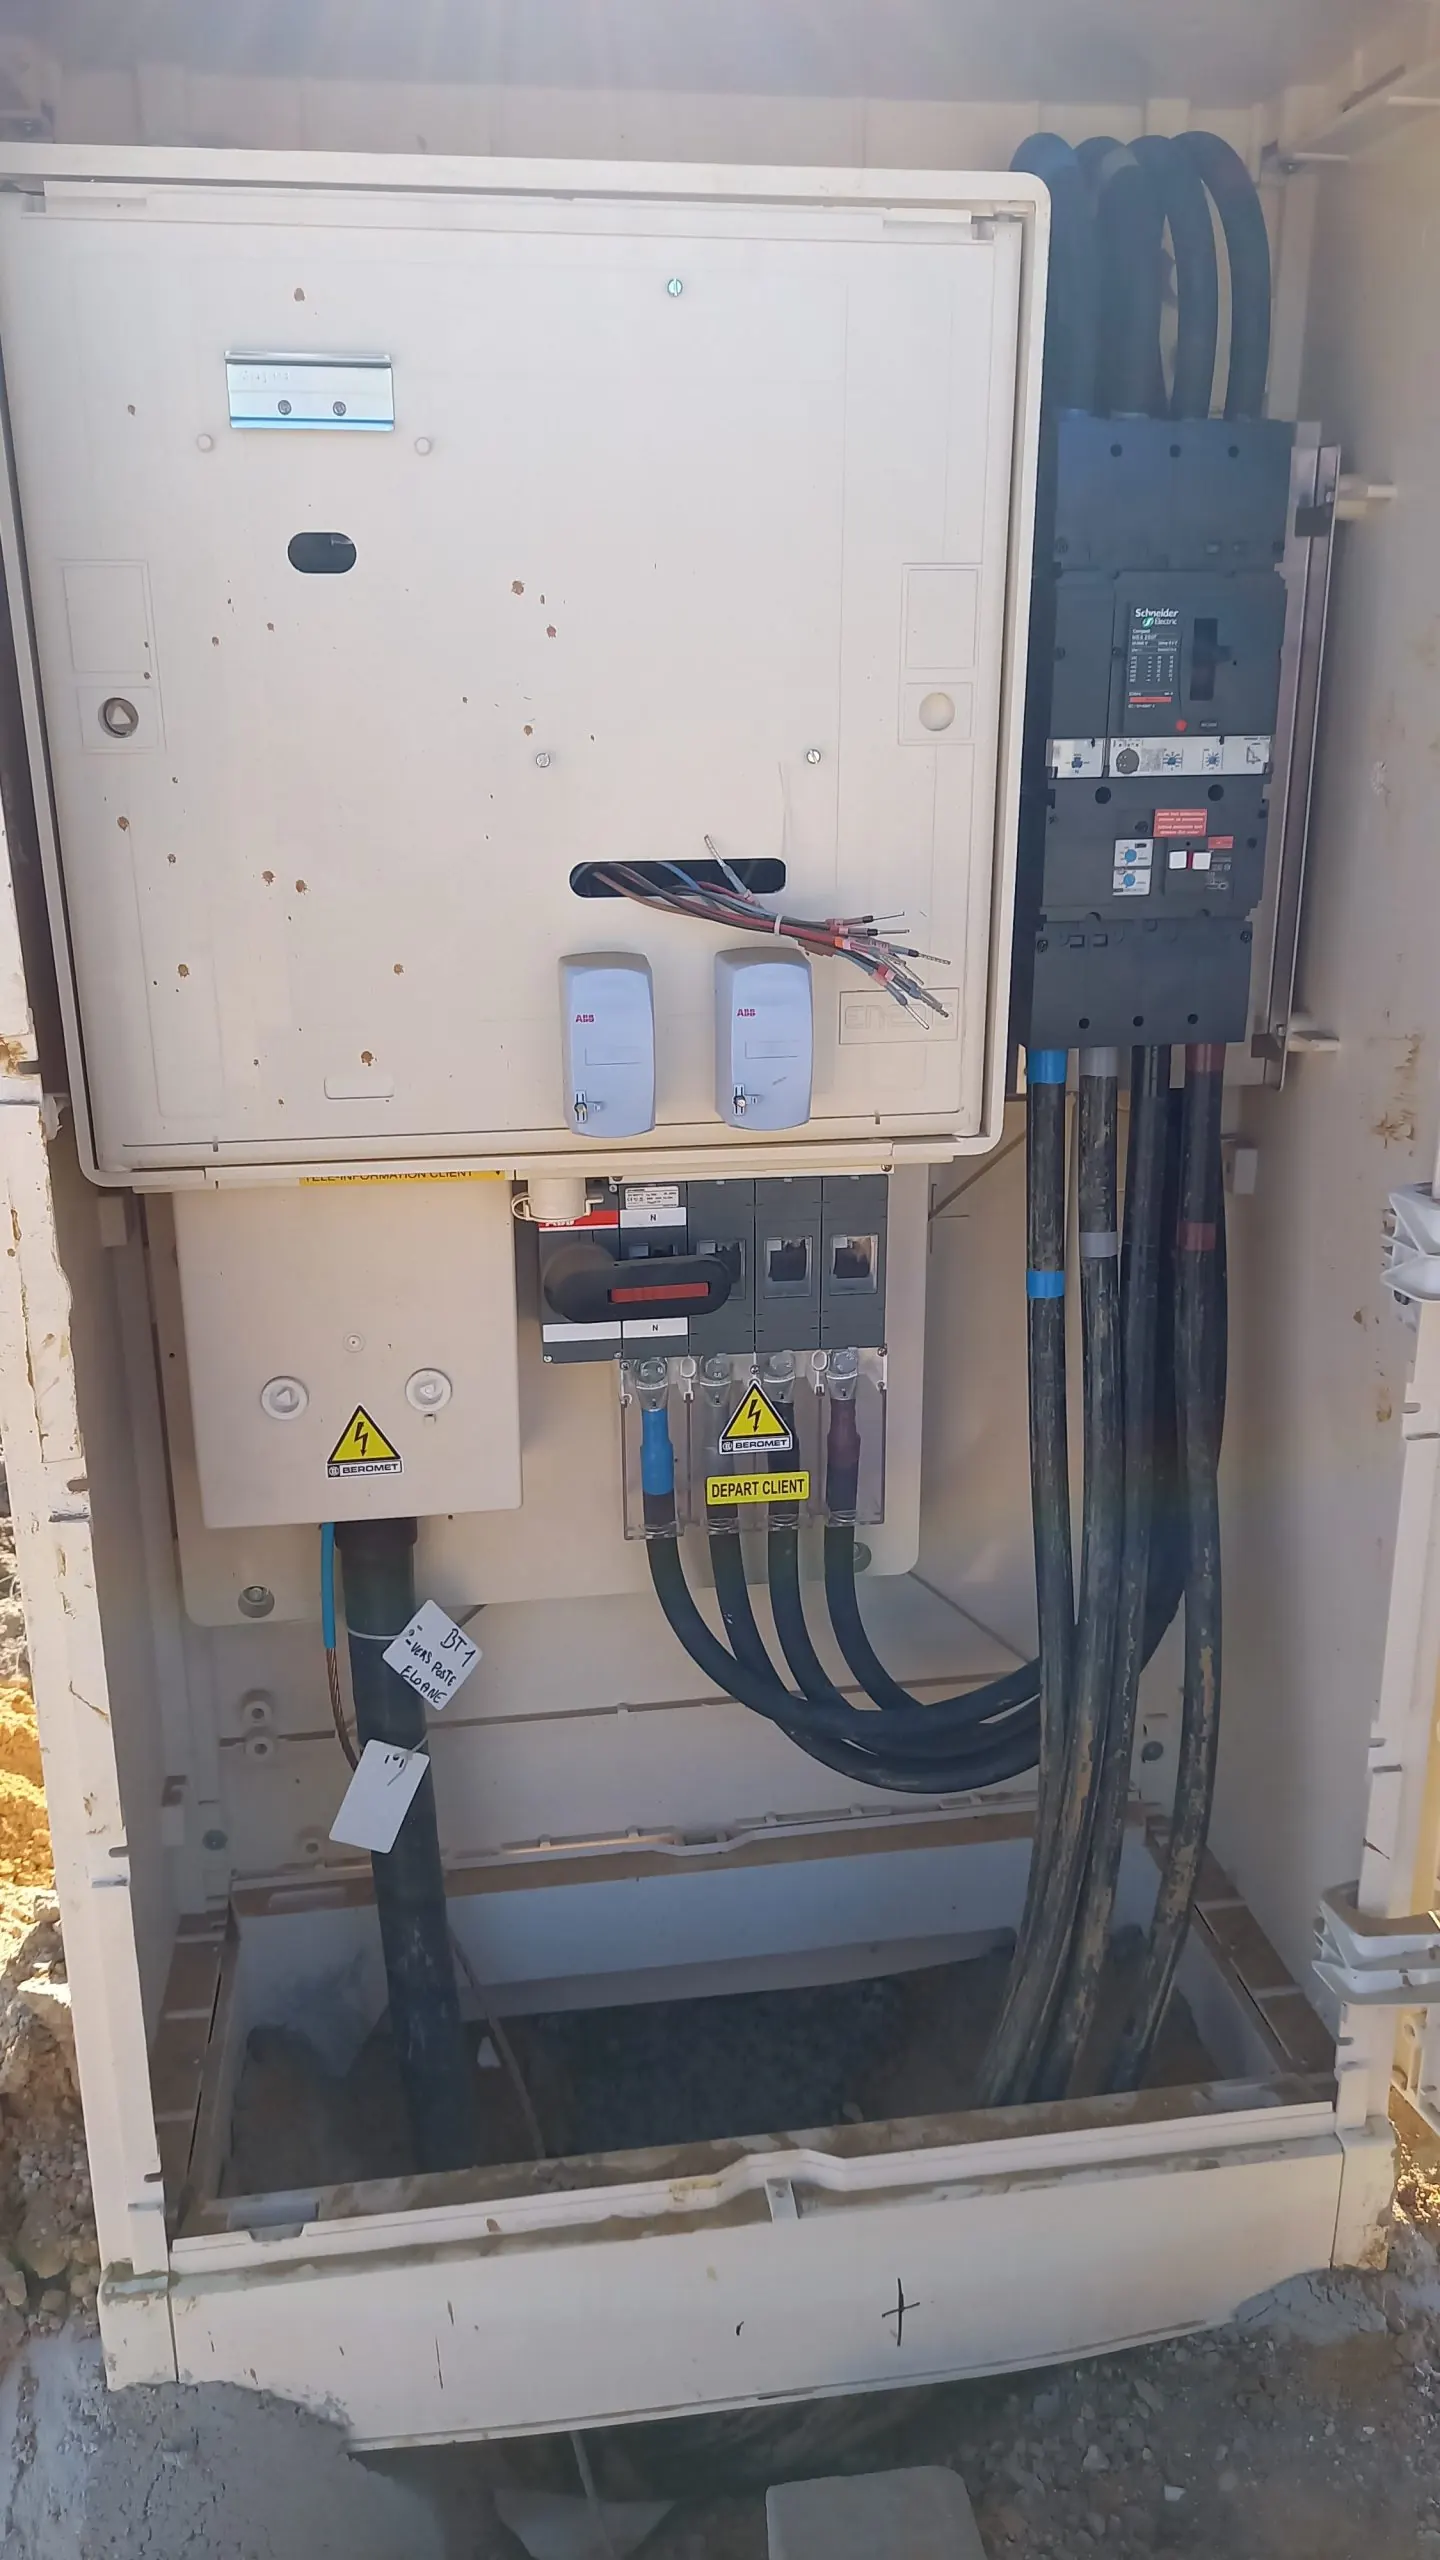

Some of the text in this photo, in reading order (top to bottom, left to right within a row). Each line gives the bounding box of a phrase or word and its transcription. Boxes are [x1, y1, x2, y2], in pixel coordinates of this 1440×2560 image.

[1135, 607, 1179, 618] Schneider
[1154, 617, 1177, 625] Electric
[737, 1008, 756, 1017] ABB
[575, 1014, 595, 1023] ABB
[650, 1213, 657, 1221] N
[652, 1324, 659, 1332] N
[735, 1439, 787, 1449] BEROMET
[342, 1463, 399, 1474] BEROMET
[712, 1479, 804, 1498] DEPART CLIENT
[440, 1628, 467, 1652] BT
[399, 1665, 448, 1703] ELOANE
